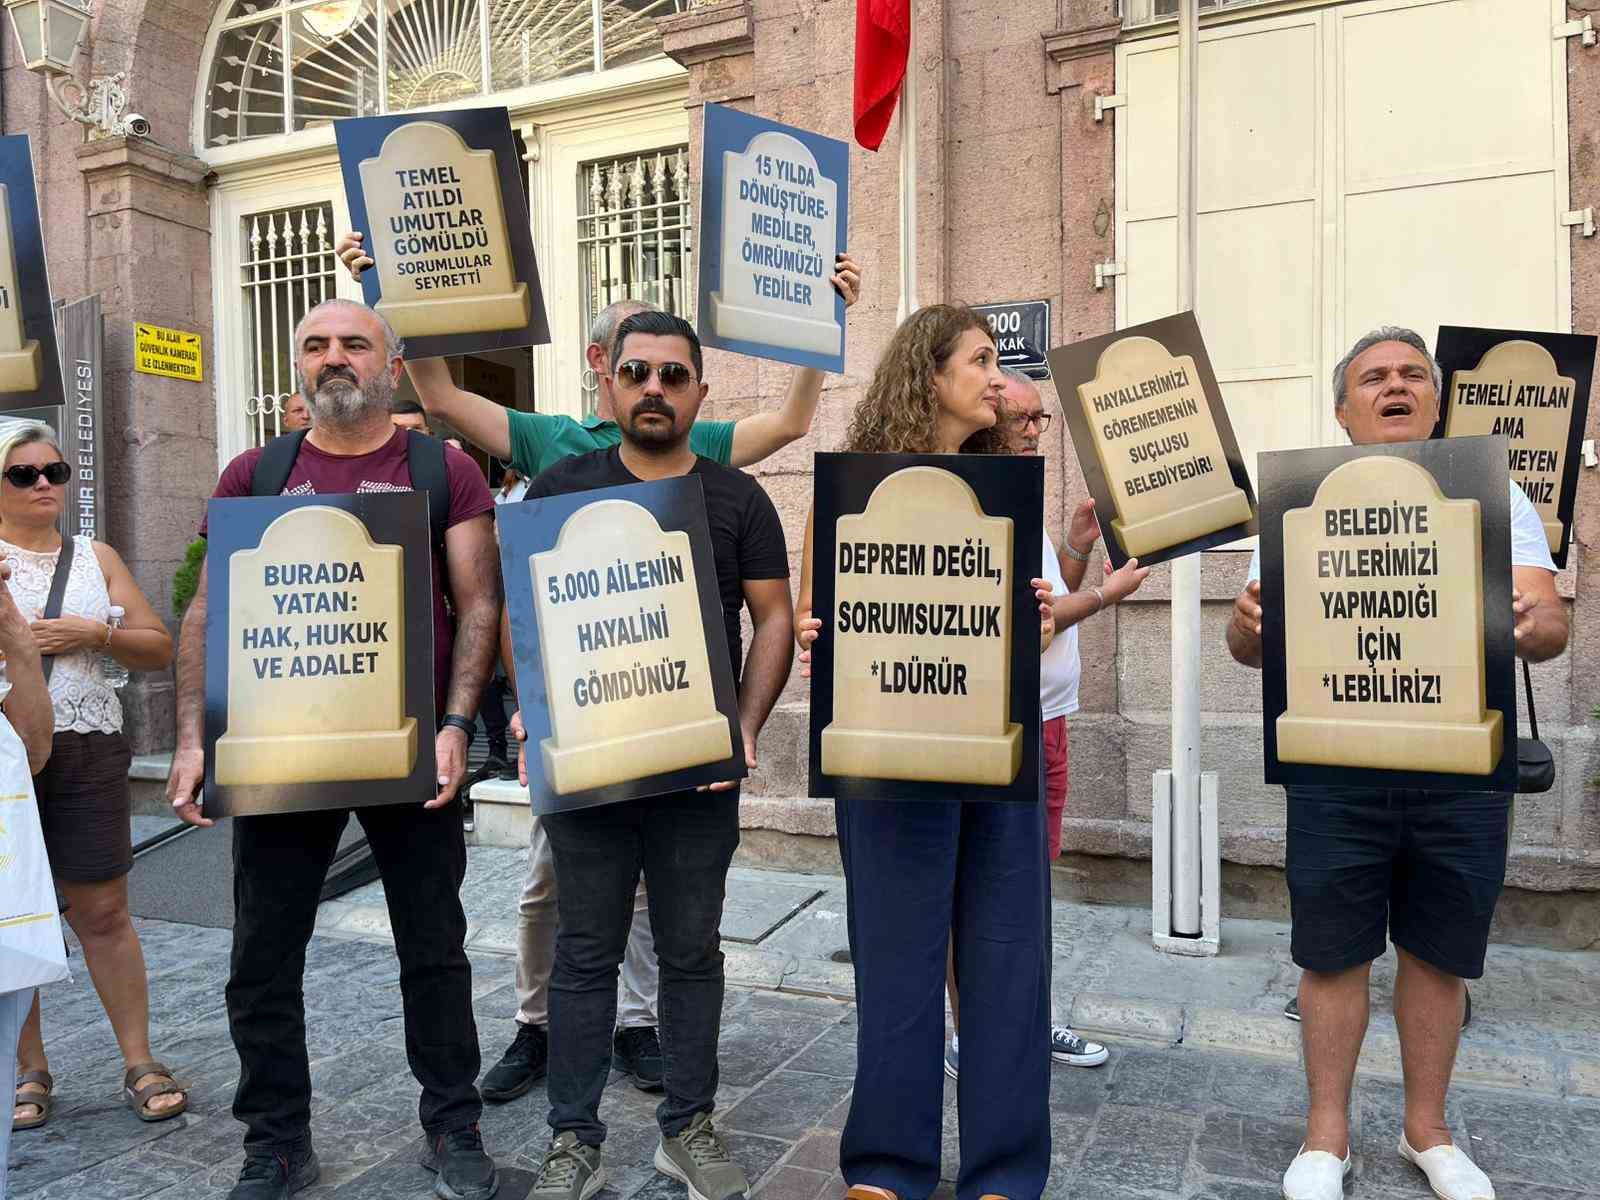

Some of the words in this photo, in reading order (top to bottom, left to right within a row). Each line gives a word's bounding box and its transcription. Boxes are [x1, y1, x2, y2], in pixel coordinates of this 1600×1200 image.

[396, 166, 460, 188] TEMEL
[756, 154, 771, 176] 15
[776, 158, 816, 188] YILDA
[403, 188, 462, 210] ATILDI
[390, 209, 484, 233] UMUTLAR
[752, 213, 816, 250] MEDİLER,
[394, 228, 488, 256] GÖMÜLDÜ
[742, 236, 822, 278] ÖMRÜMÜZÜ
[397, 254, 492, 276] SORUMLULAR
[415, 269, 481, 290] SEYRETTİ
[753, 274, 812, 306] YEDİLER
[996, 337, 1025, 352] KAK
[1093, 366, 1190, 413] HAYALLERİMİZİ
[1458, 380, 1512, 406] TEMELİ
[1515, 385, 1569, 408] ATILAN
[1104, 398, 1198, 440] GÖREMEMENİN
[1492, 417, 1524, 439] AMA
[1129, 432, 1189, 464] SUÇLUSU
[1509, 450, 1558, 472] MEYEN
[1124, 456, 1213, 496] BELEDİYEDİR!
[1516, 478, 1554, 504] İMİZ
[1326, 500, 1428, 536] BELEDİYE
[264, 562, 365, 587] BURADA
[840, 542, 925, 576] DEPREM
[933, 538, 1001, 585] DEĞİL,
[1318, 540, 1438, 578] EVLERİMİZİ
[548, 569, 600, 604] 5.000
[607, 551, 684, 594] AİLENİN
[272, 592, 357, 614] YATAN:
[1320, 583, 1437, 619] YAPMADIĞI
[578, 604, 669, 652] HAYALİNİ
[838, 601, 1000, 637] SORUMSUZLUK
[242, 626, 299, 650] HAK,
[307, 622, 388, 646] HUKUK
[1358, 626, 1401, 667] İÇİN
[254, 657, 282, 679] VE
[289, 652, 379, 677] ADALET
[574, 657, 690, 707] GÖMDÜNÜZ
